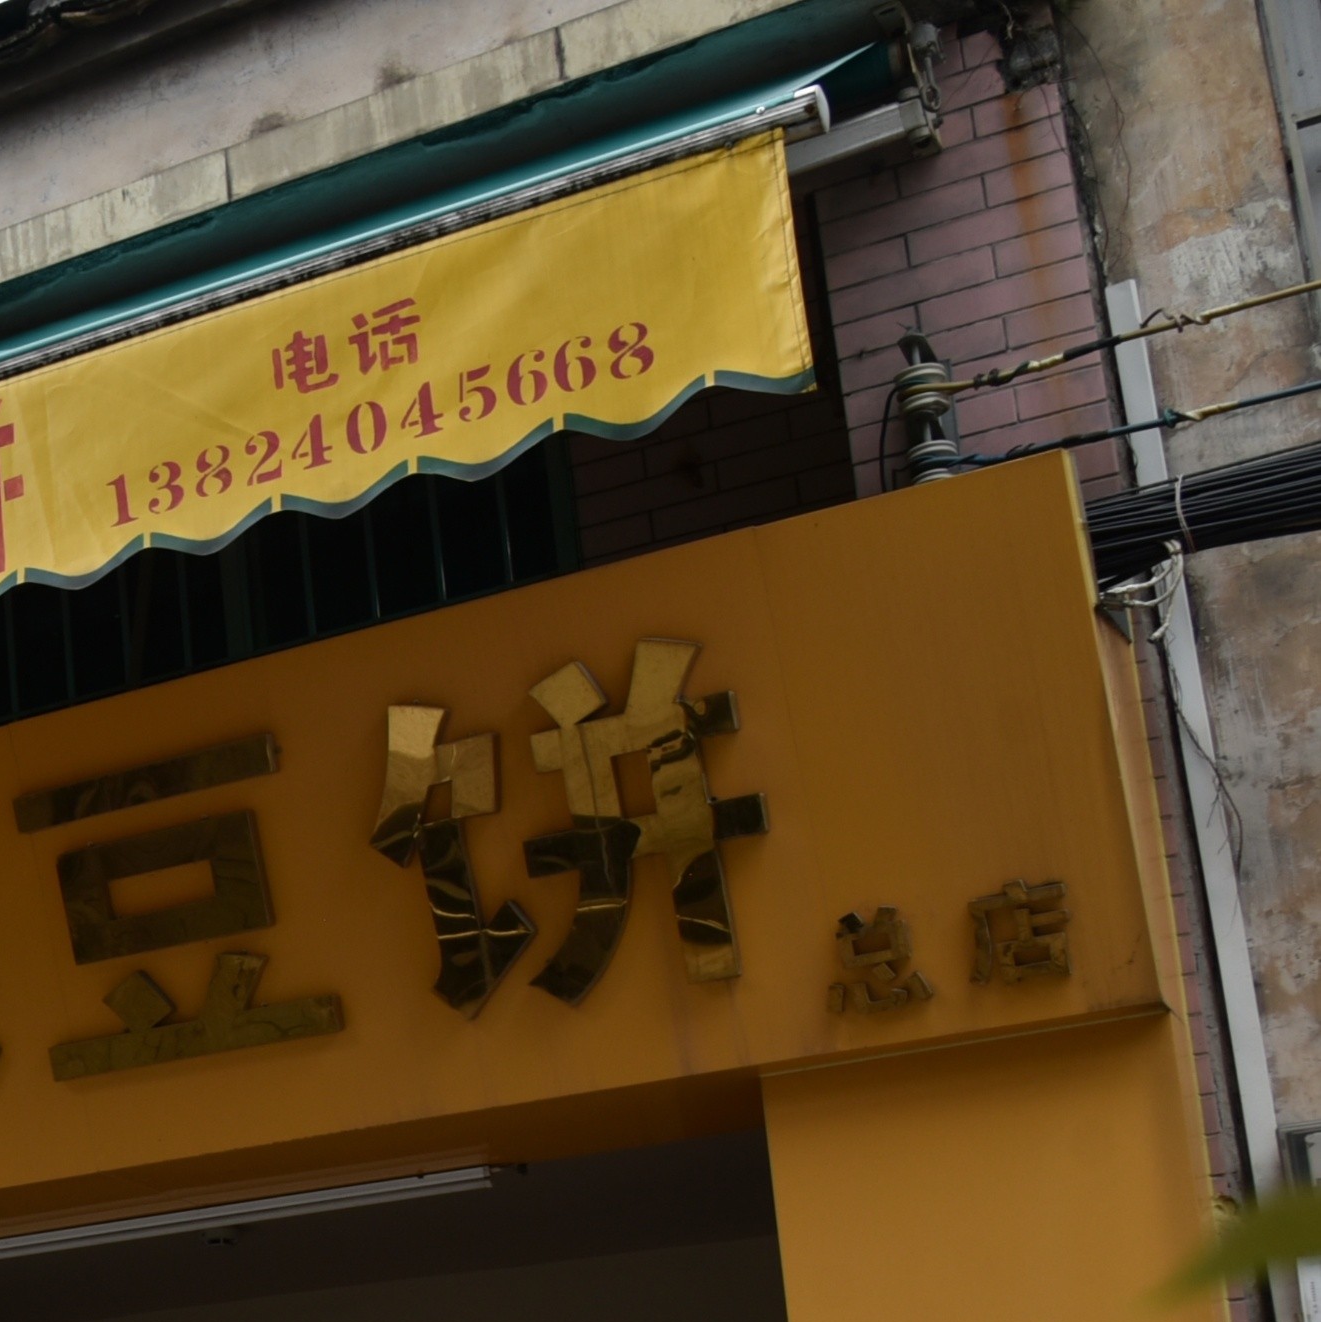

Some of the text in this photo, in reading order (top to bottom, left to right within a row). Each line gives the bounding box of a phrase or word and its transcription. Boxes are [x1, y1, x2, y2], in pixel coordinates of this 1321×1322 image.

[272, 296, 420, 396] 电话
[106, 320, 656, 528] 13824045668
[824, 878, 1074, 1014] 总店
